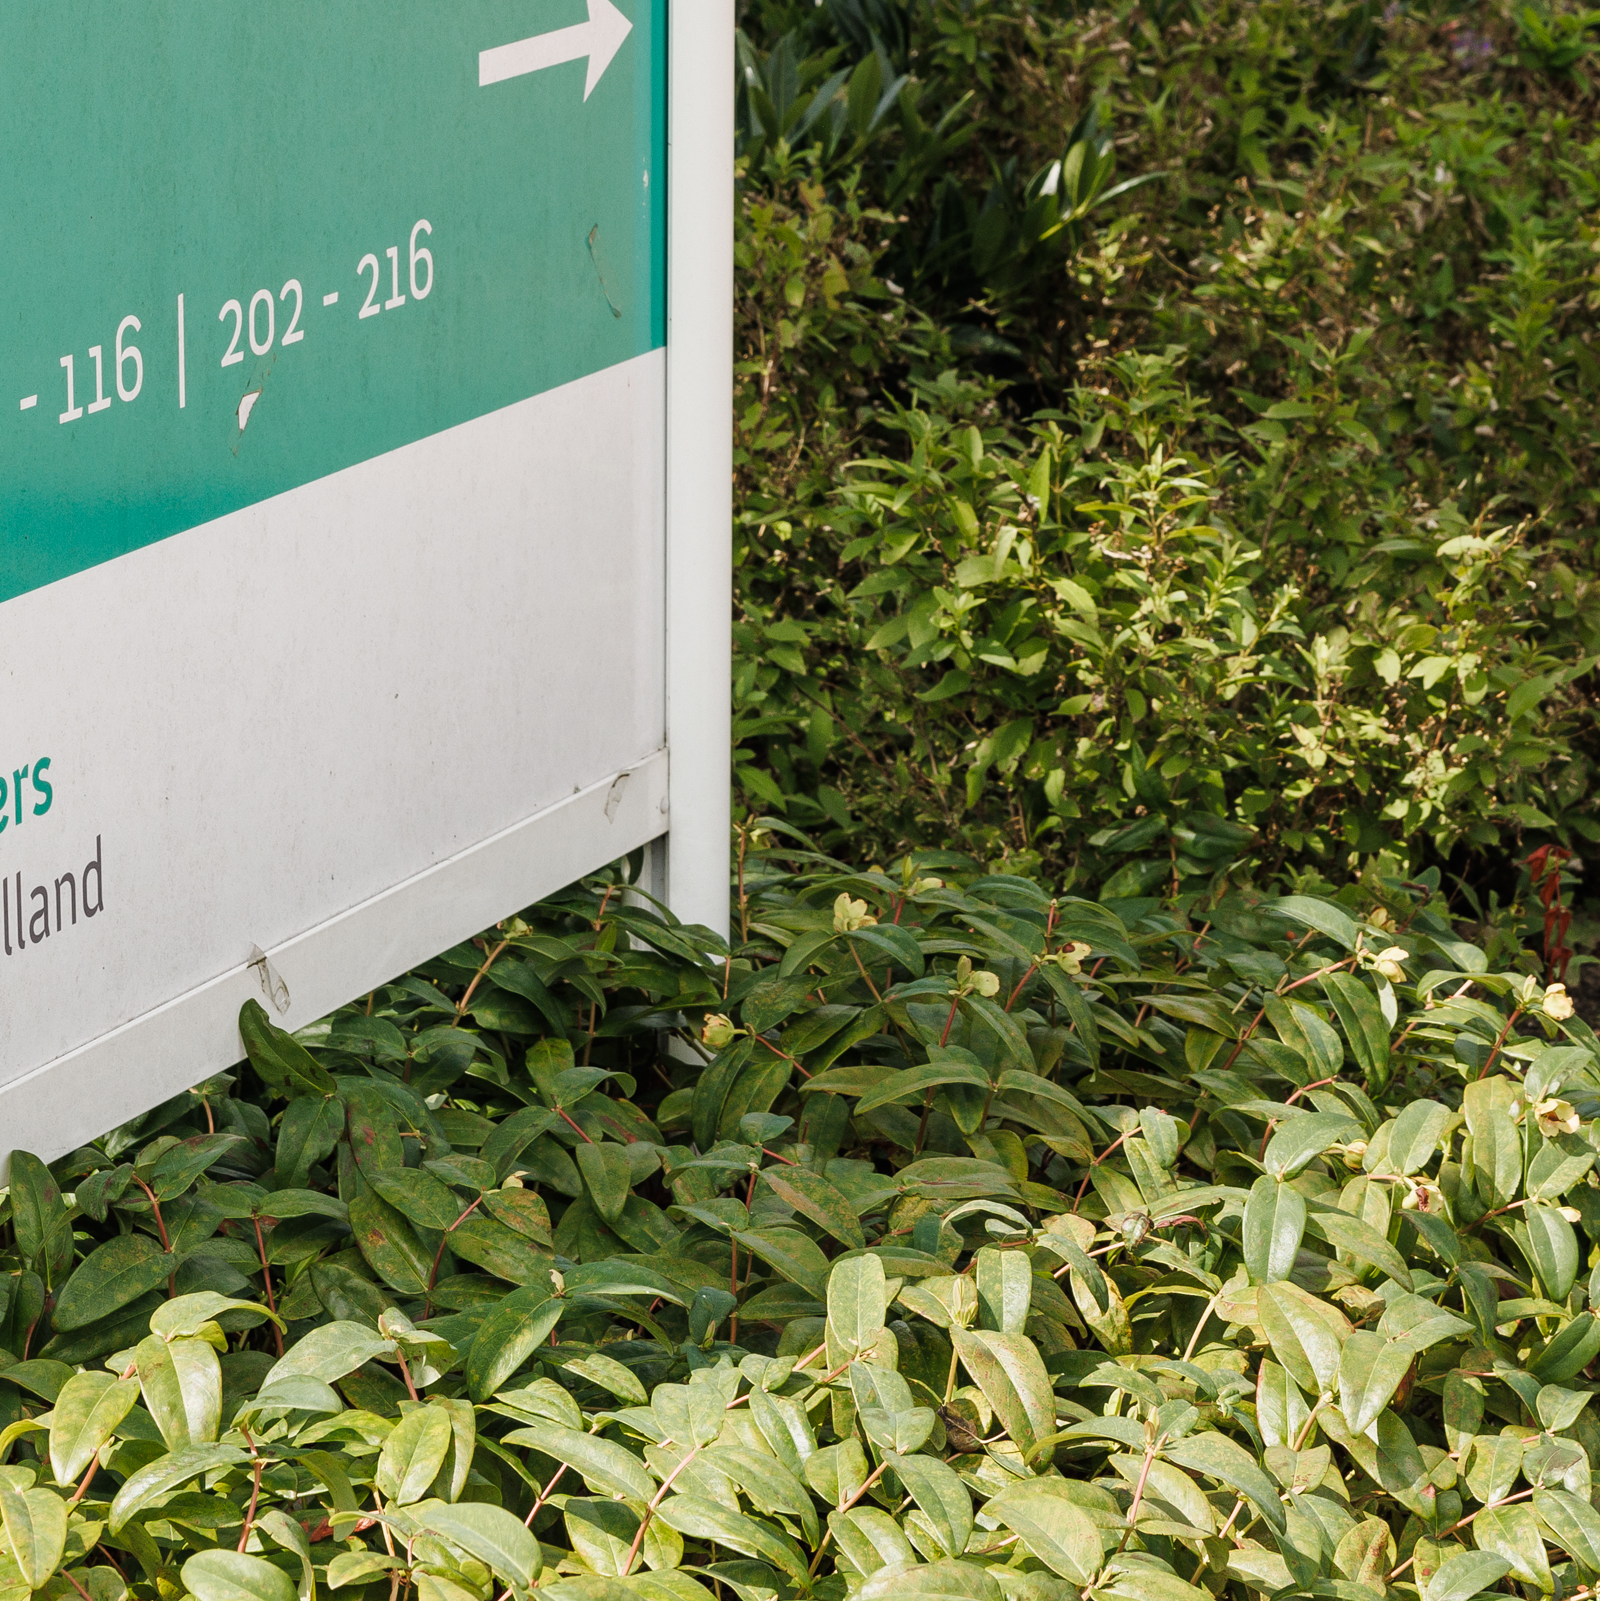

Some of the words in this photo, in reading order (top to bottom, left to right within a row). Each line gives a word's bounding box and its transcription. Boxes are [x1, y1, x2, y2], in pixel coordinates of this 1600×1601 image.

[59, 314, 144, 425] 116
[218, 278, 305, 368] 202
[356, 218, 434, 320] 216
